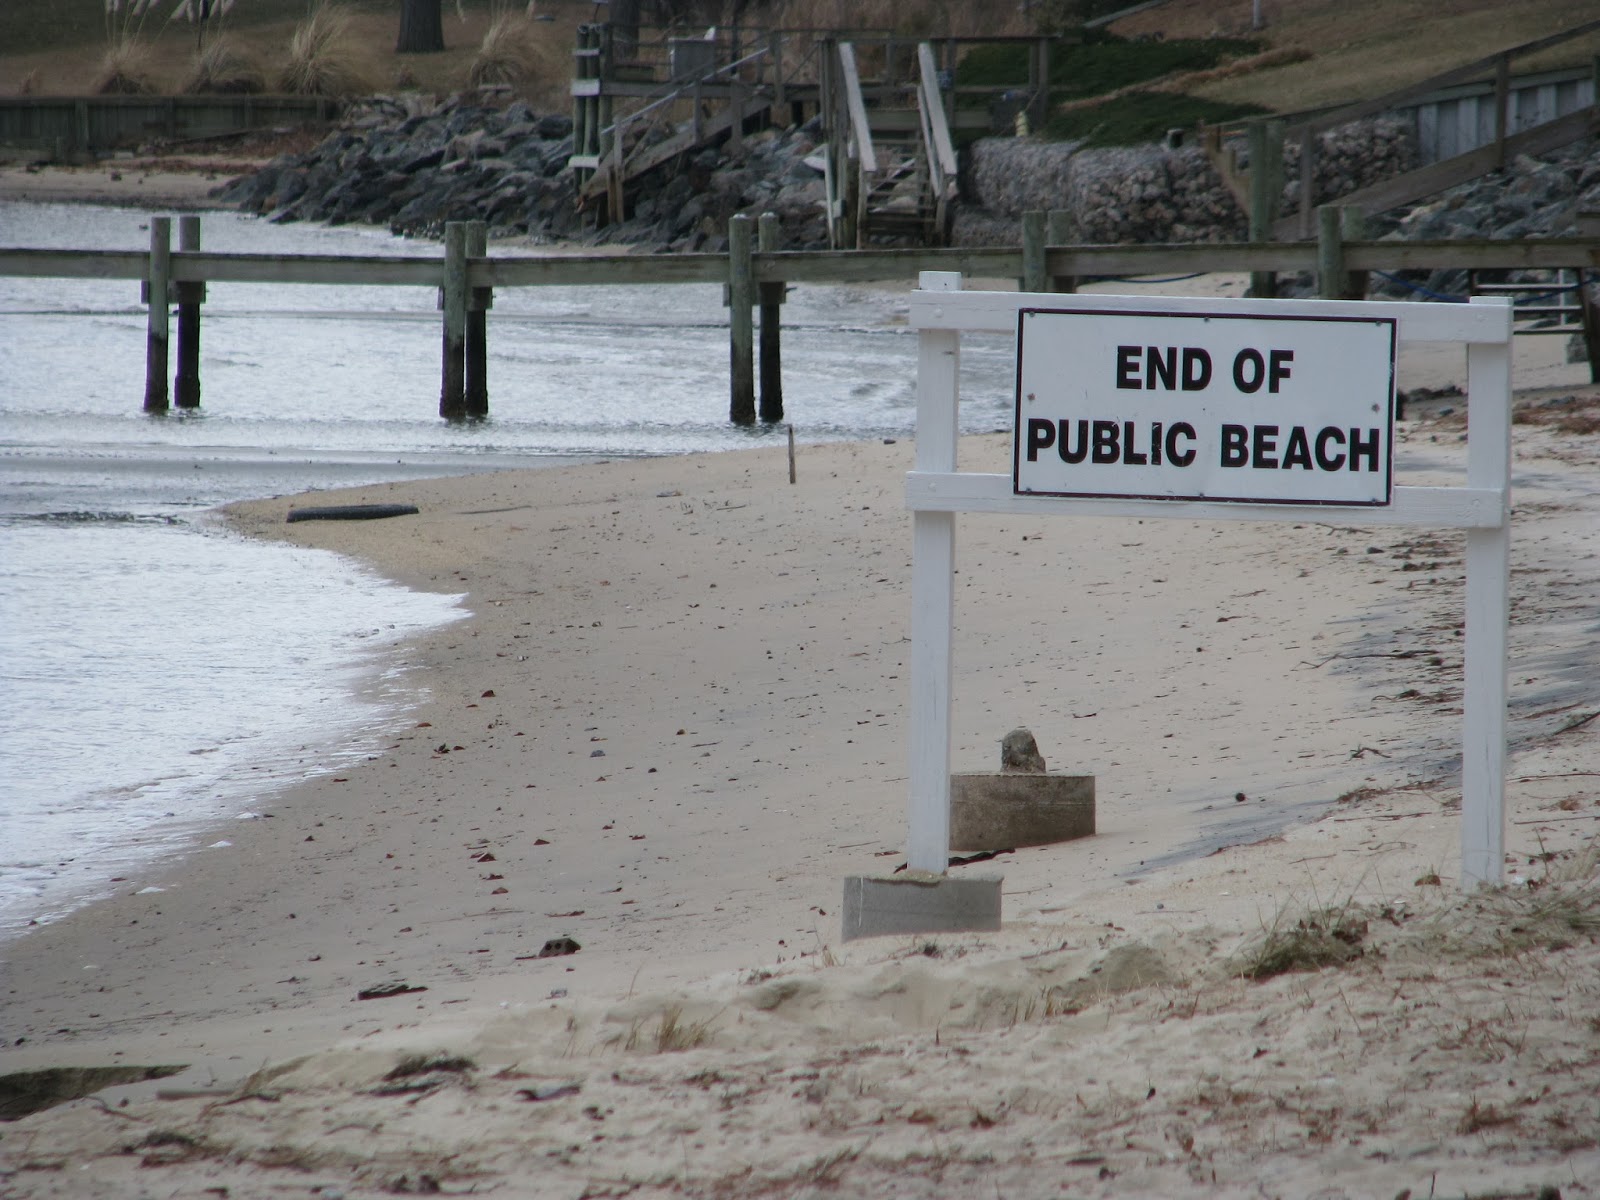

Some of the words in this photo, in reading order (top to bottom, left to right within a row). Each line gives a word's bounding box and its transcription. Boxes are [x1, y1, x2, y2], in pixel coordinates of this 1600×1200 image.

[1115, 345, 1213, 392] END
[1232, 347, 1295, 394] OF
[1026, 417, 1197, 468] PUBLIC
[1220, 423, 1380, 473] BEACH
